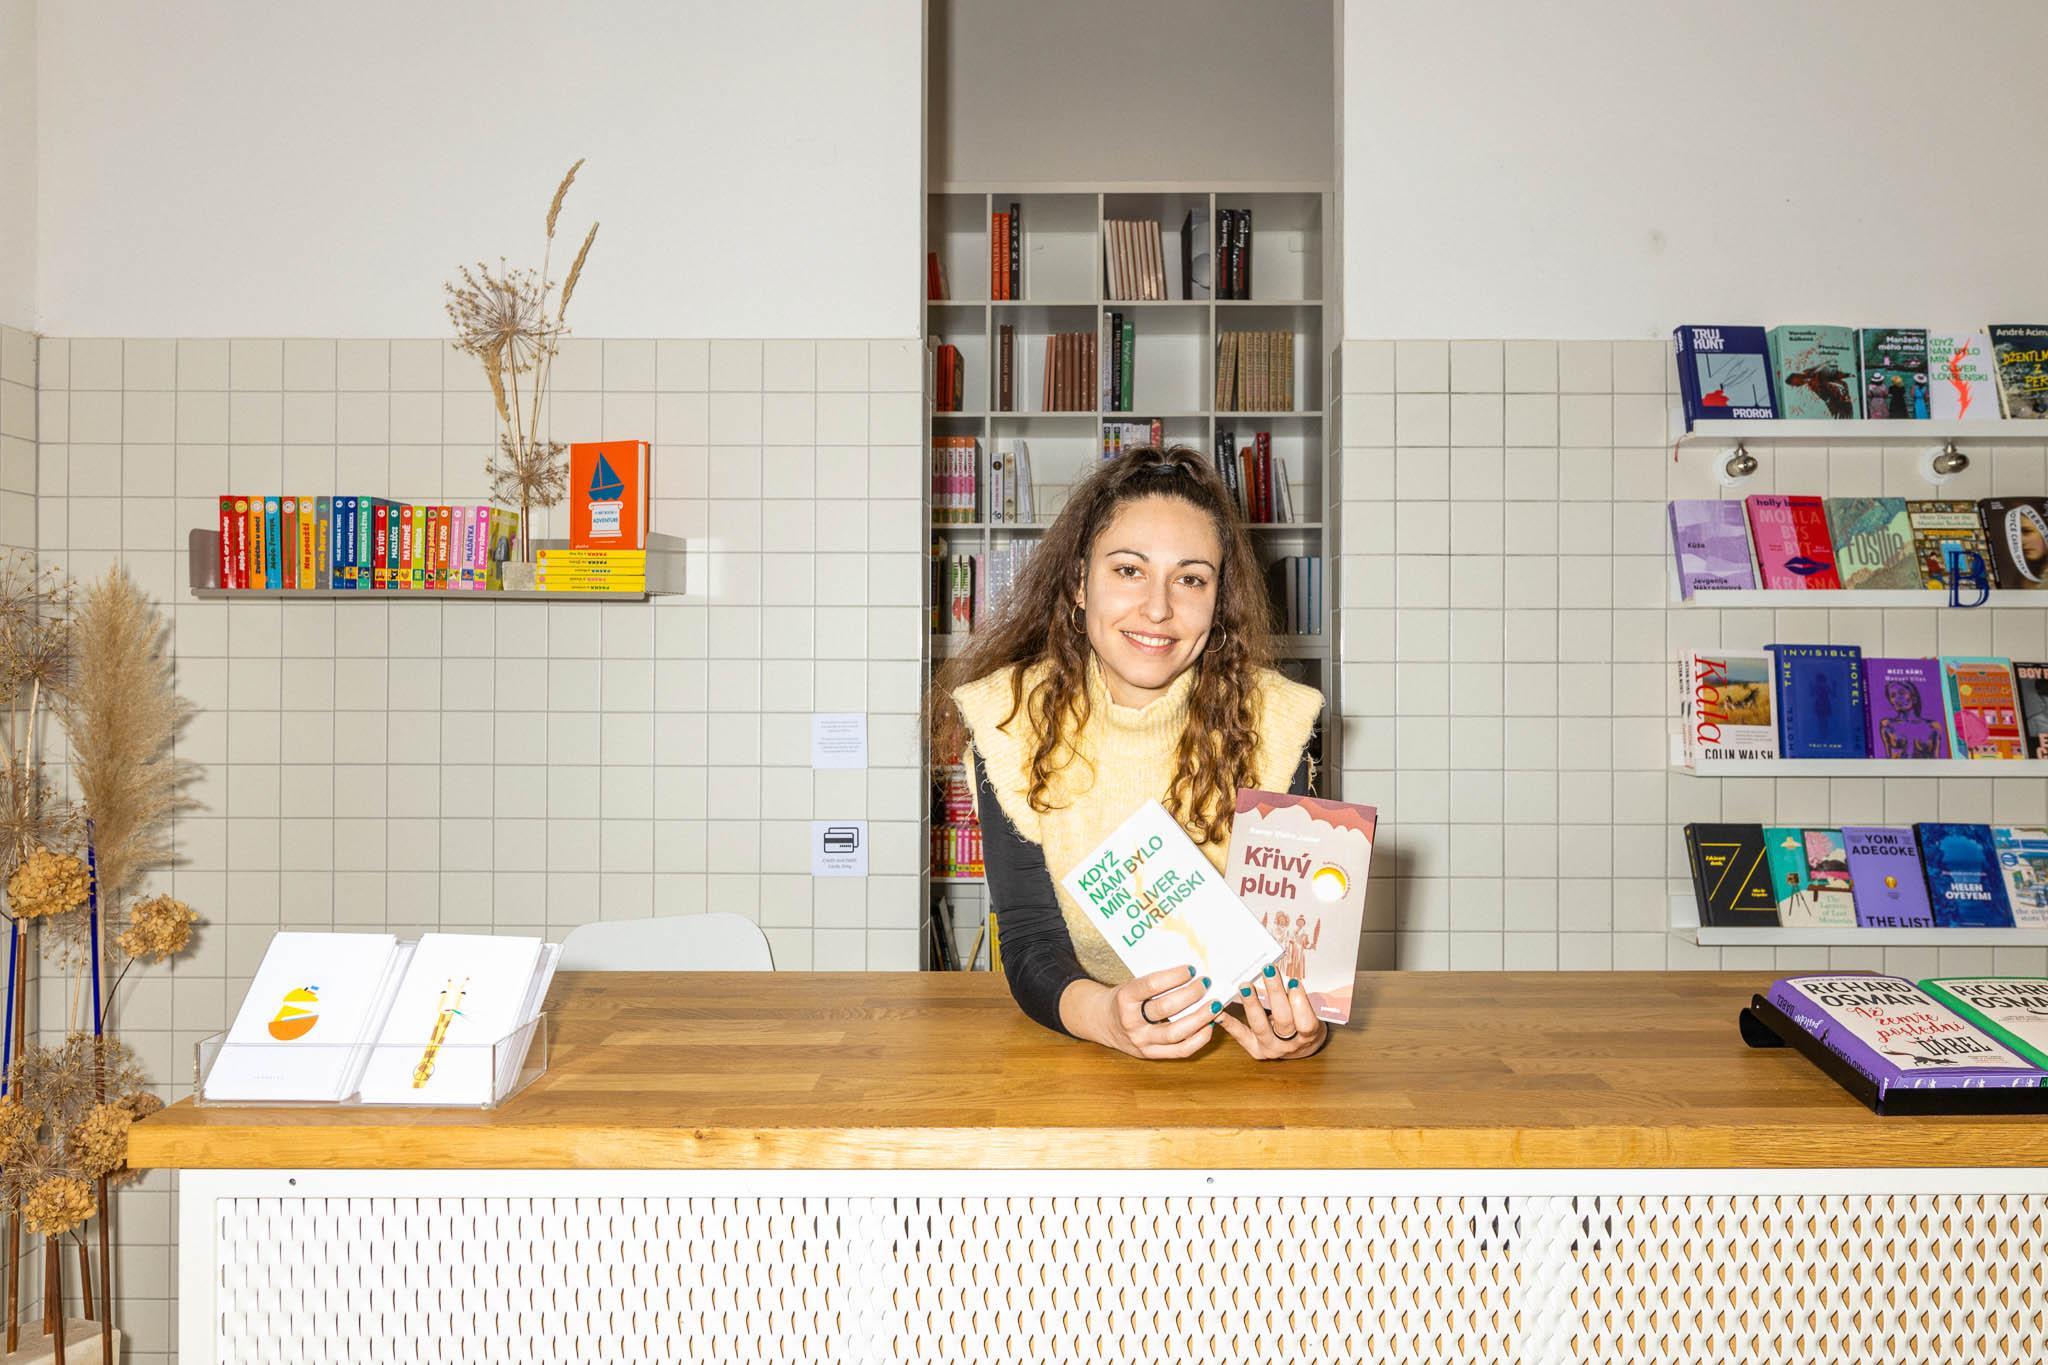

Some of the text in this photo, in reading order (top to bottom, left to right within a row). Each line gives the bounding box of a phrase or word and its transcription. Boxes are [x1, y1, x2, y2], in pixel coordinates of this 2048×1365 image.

[1996, 328, 2025, 336] André
[1886, 335, 1924, 345] Manželky
[1755, 498, 1781, 508] holly
[1759, 510, 1822, 525] MOHLA
[439, 541, 447, 561] MOJE
[1783, 649, 1856, 657] INVISIBLE
[1783, 662, 1791, 687] THE
[2018, 668, 2041, 679] BOY
[1850, 662, 1859, 707] HOTEL
[1694, 653, 1728, 746] Kala
[1865, 833, 1898, 844] YOMI
[1852, 845, 1916, 857] ADEGOKE
[1244, 845, 1312, 879] Křivý
[1078, 849, 1120, 892] KDYŽ
[1089, 835, 1163, 905] NÁM BYLO
[1126, 869, 1180, 919] OLIVER
[1239, 873, 1297, 900] pluh
[1951, 883, 1983, 892] HELEN
[1100, 886, 1132, 919] MÍŇ
[1945, 891, 1992, 901] OYEYEMI
[1122, 870, 1206, 948] LOVRENSKI
[1866, 915, 1930, 928] THE LIST
[1820, 993, 1931, 1007] OSMAN
